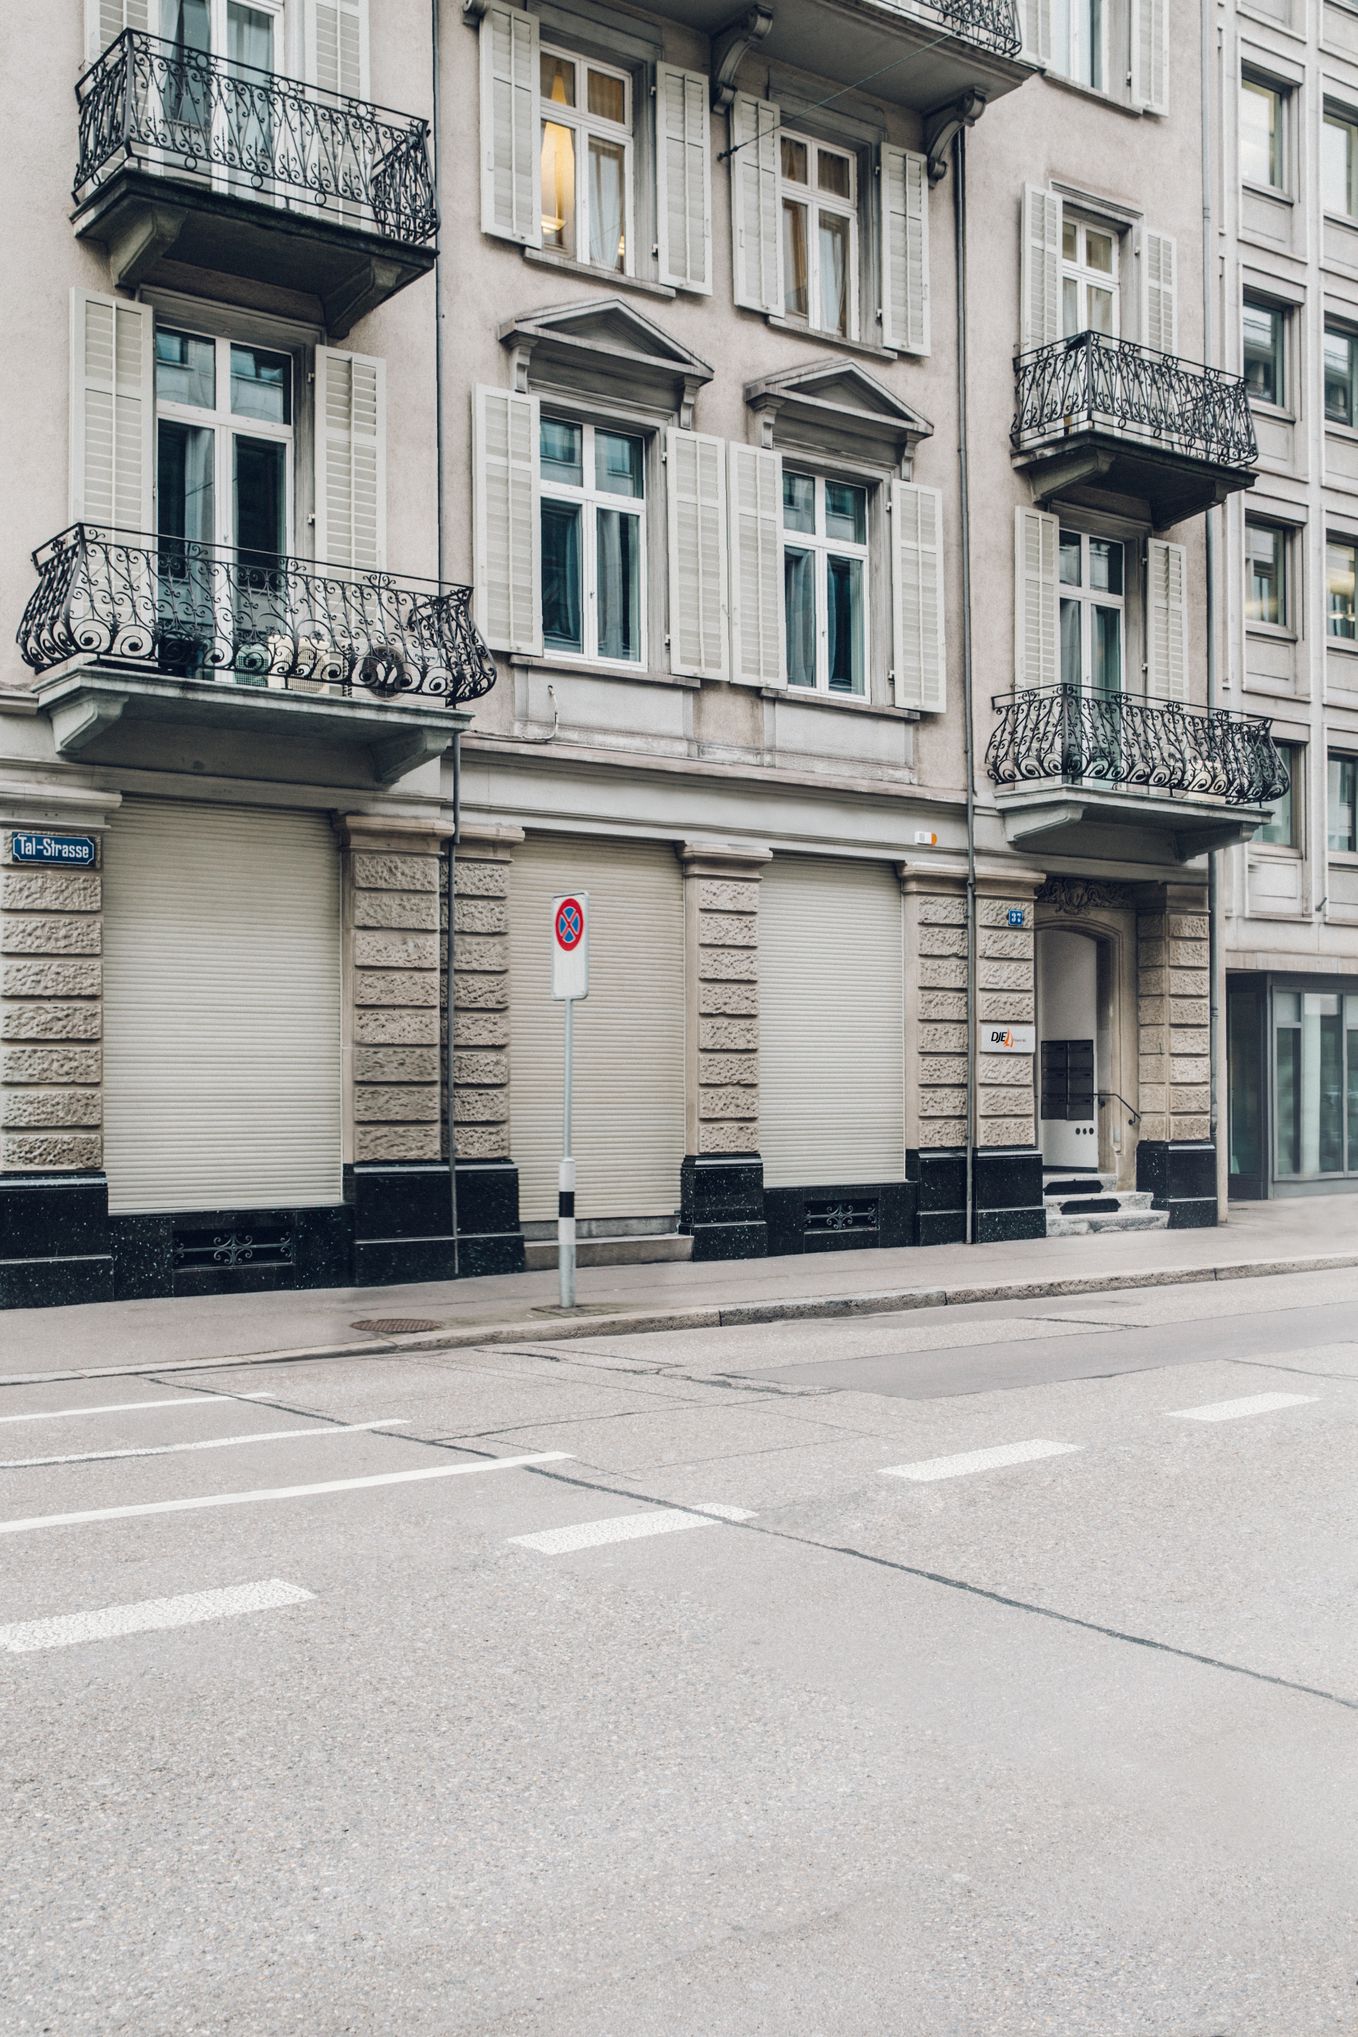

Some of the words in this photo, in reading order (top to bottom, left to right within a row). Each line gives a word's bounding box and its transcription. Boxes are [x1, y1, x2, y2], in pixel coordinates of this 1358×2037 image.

[18, 837, 89, 858] Tal-Strasse
[1011, 912, 1022, 923] 37
[991, 1031, 1007, 1043] DJE
